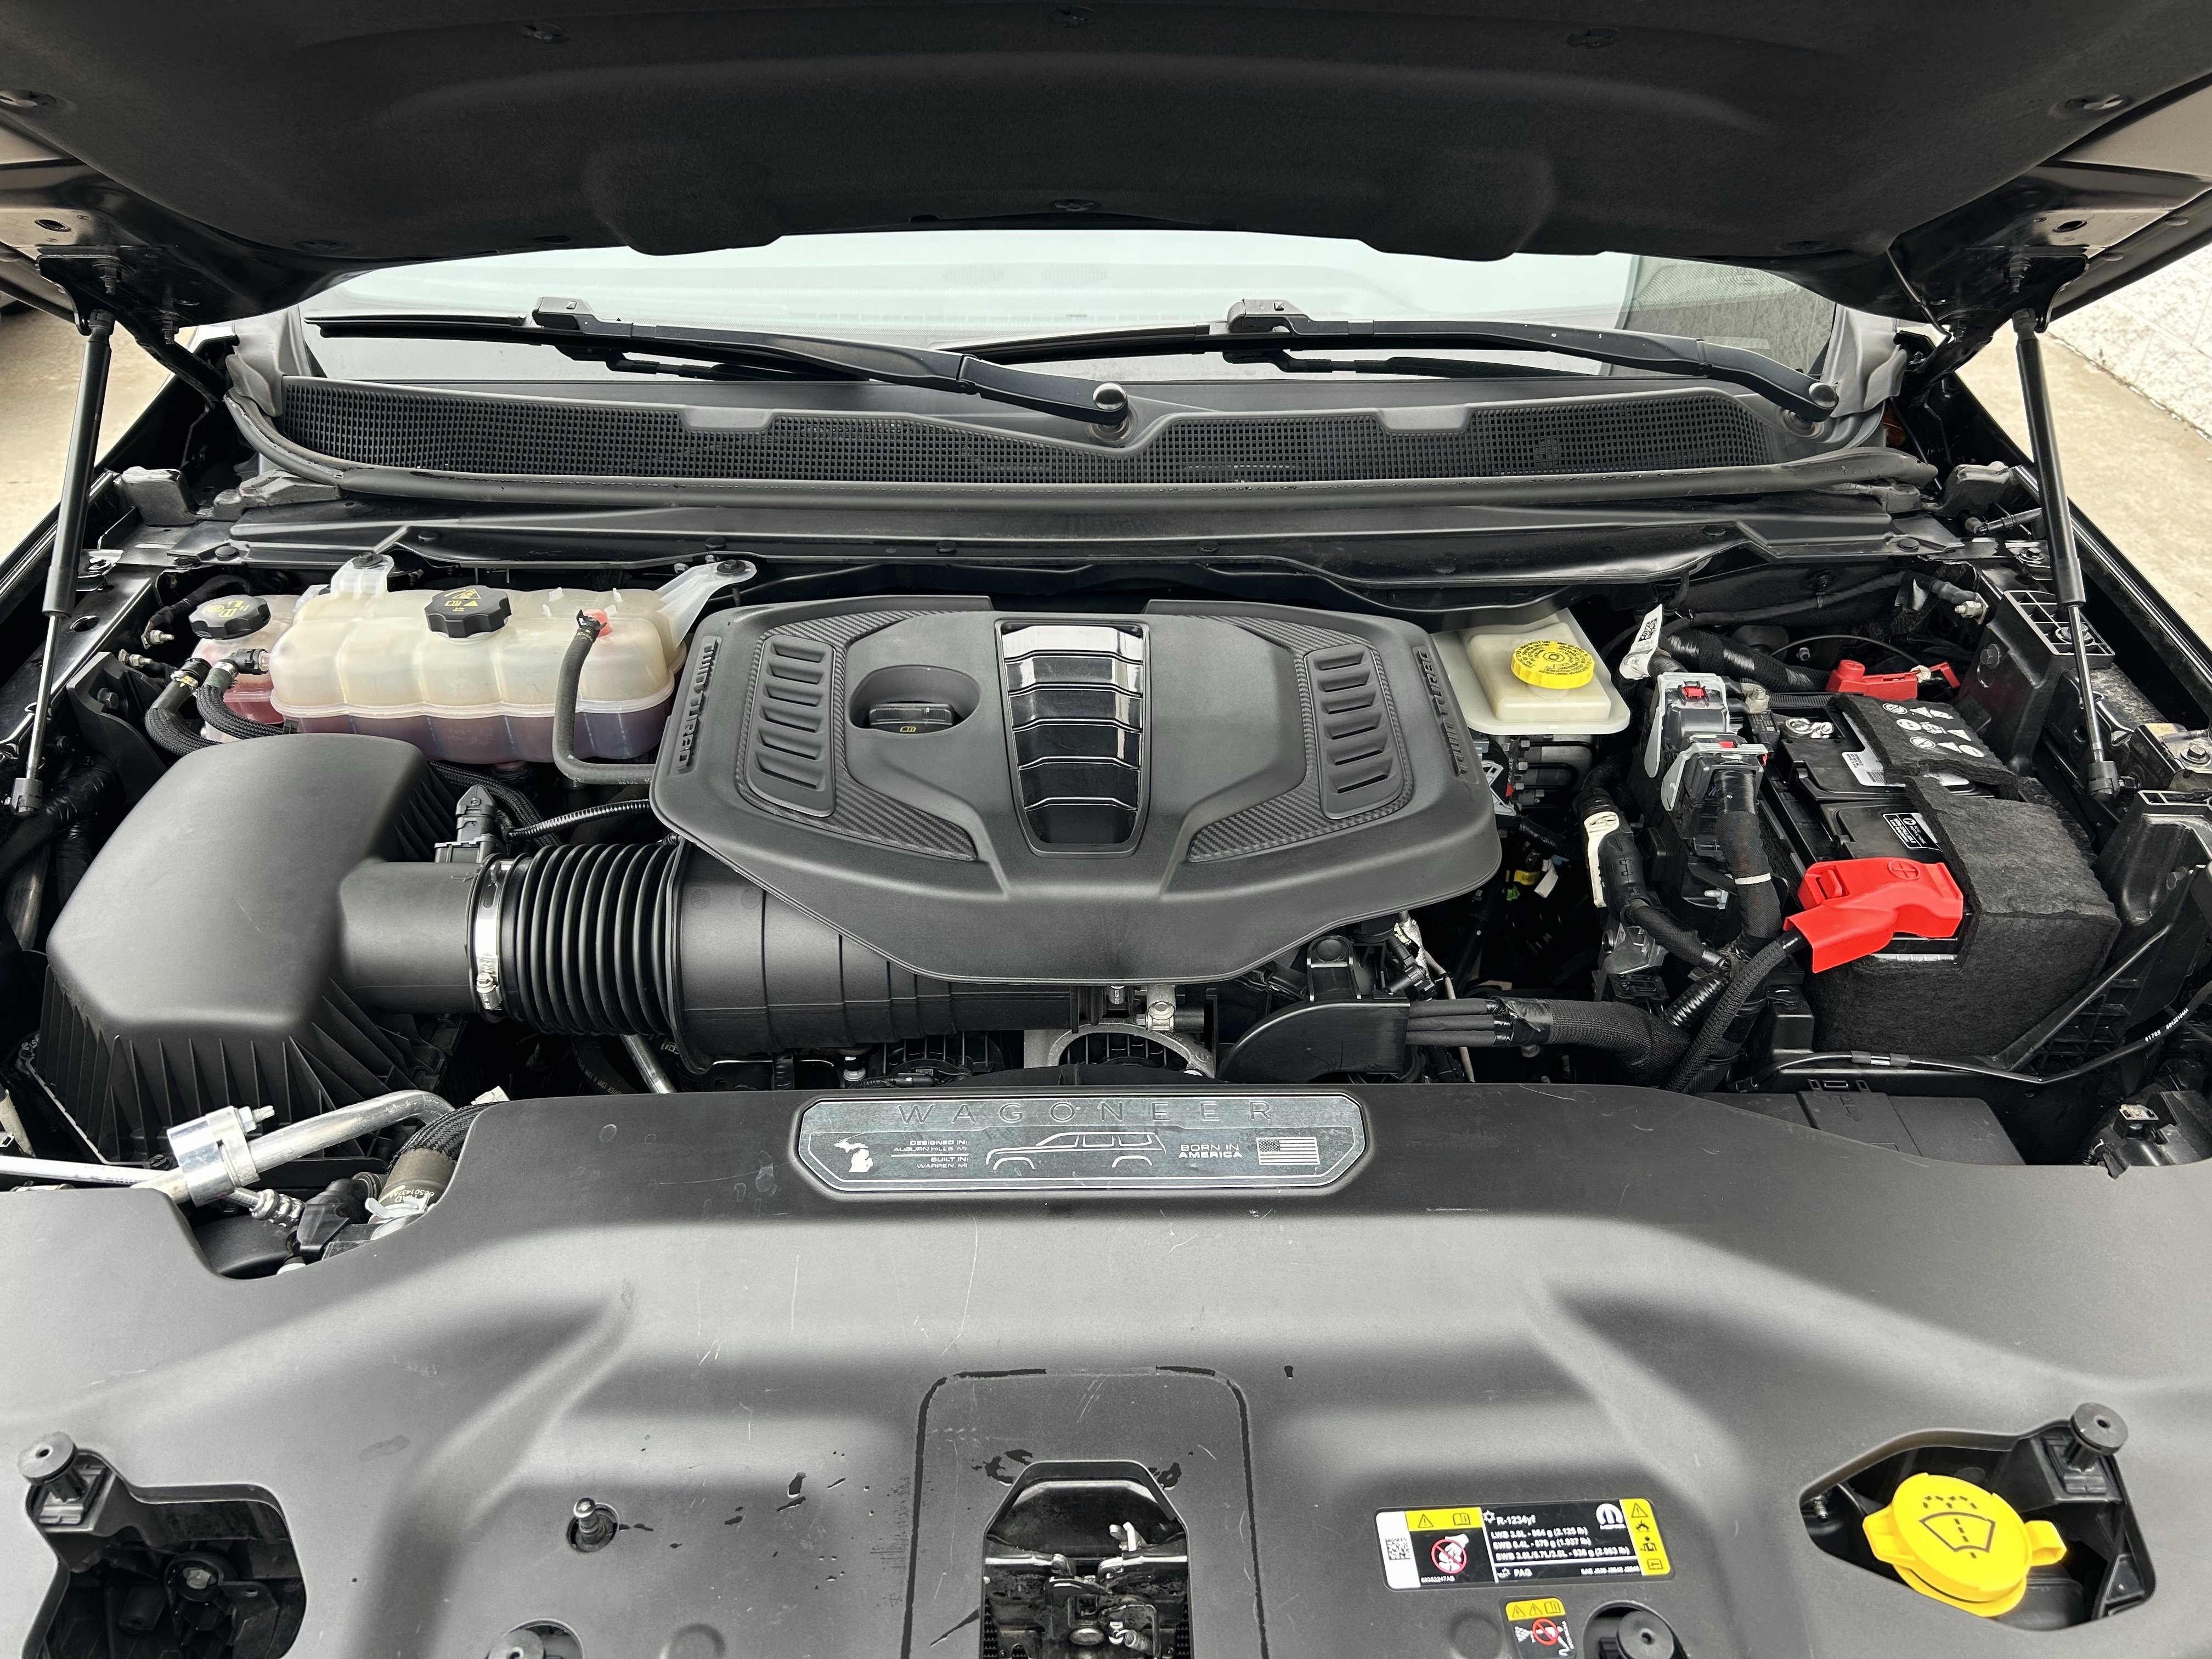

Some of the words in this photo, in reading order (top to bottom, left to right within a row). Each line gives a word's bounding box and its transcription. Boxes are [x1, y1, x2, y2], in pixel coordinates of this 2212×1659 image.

[898, 1101, 1271, 1125] WAGONEER
[1496, 1514, 1537, 1526] R-1234yf
[1491, 1531, 1509, 1539] LWB
[1576, 1526, 1589, 1536] lb)
[1492, 1541, 1513, 1550] SWB
[1579, 1537, 1592, 1547] lb)
[1496, 1552, 1516, 1561] SWB
[1618, 1546, 1630, 1556] lb)
[1513, 1568, 1533, 1577] PAG
